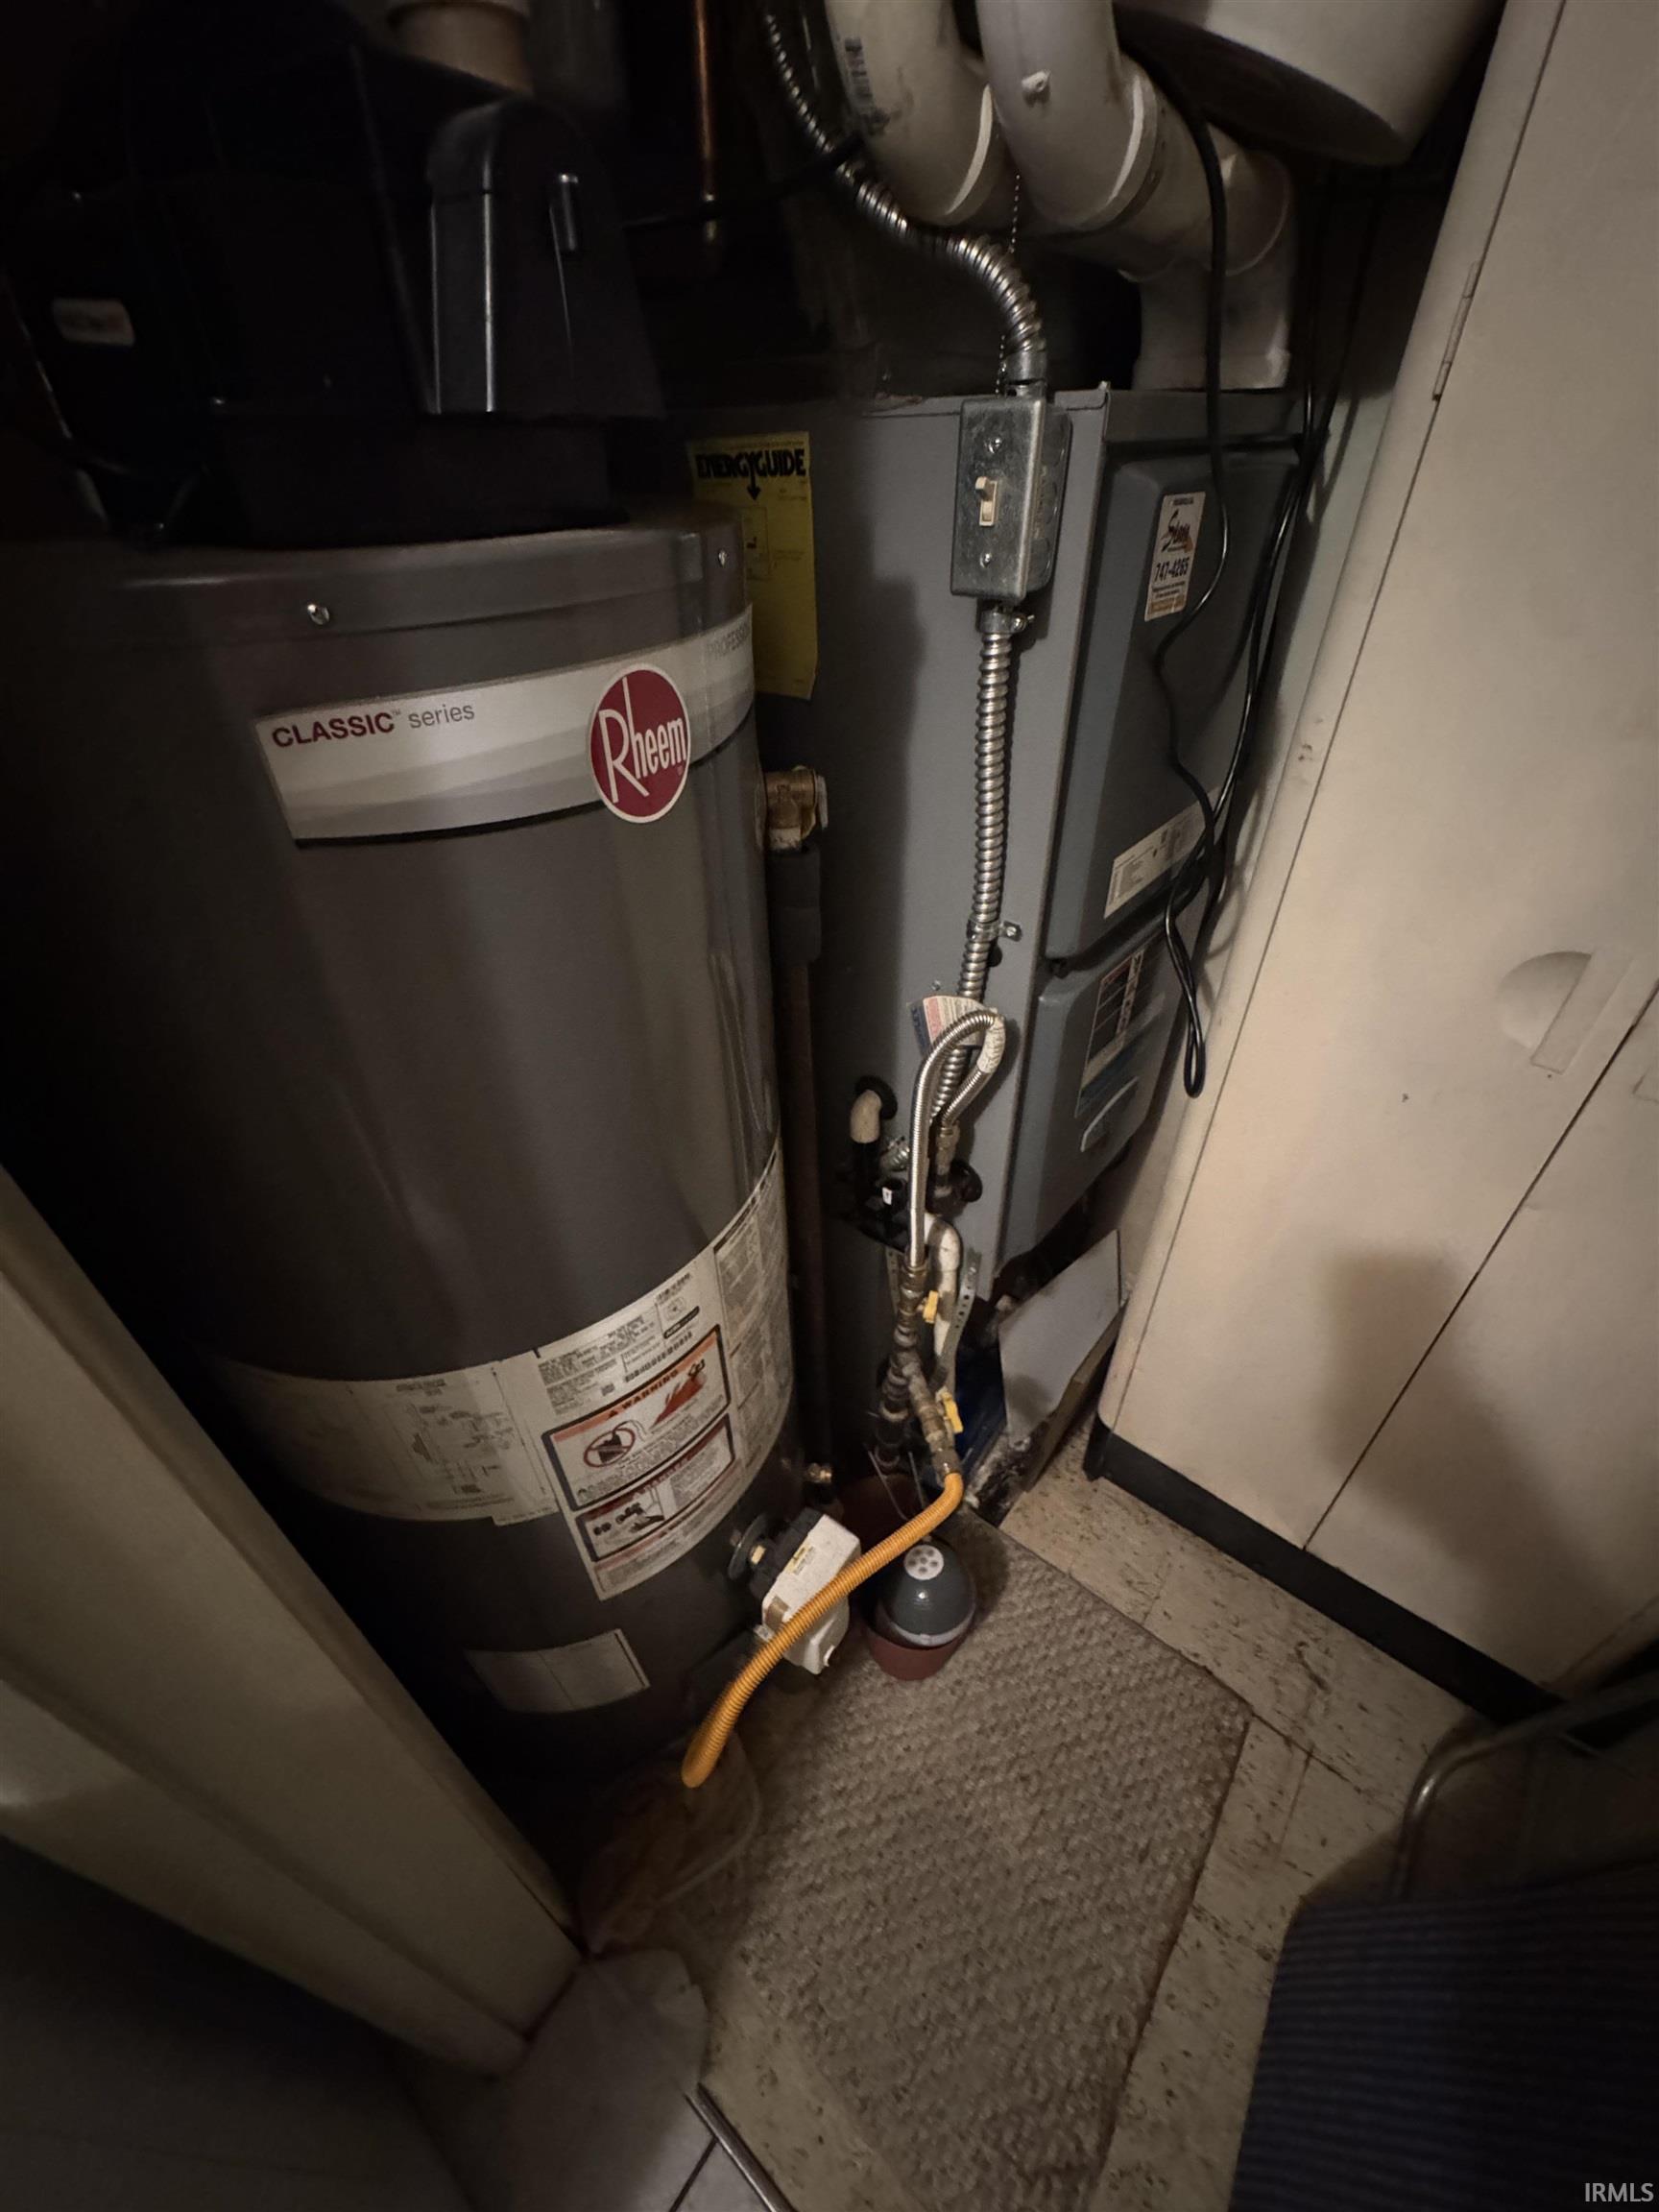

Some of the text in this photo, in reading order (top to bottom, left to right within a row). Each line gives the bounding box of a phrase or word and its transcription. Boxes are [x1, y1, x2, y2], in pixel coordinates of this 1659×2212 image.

[695, 447, 806, 478] ENERGYGUIDE
[408, 704, 475, 730] series
[597, 676, 687, 804] Rheem
[622, 1368, 680, 1410] WARNING
